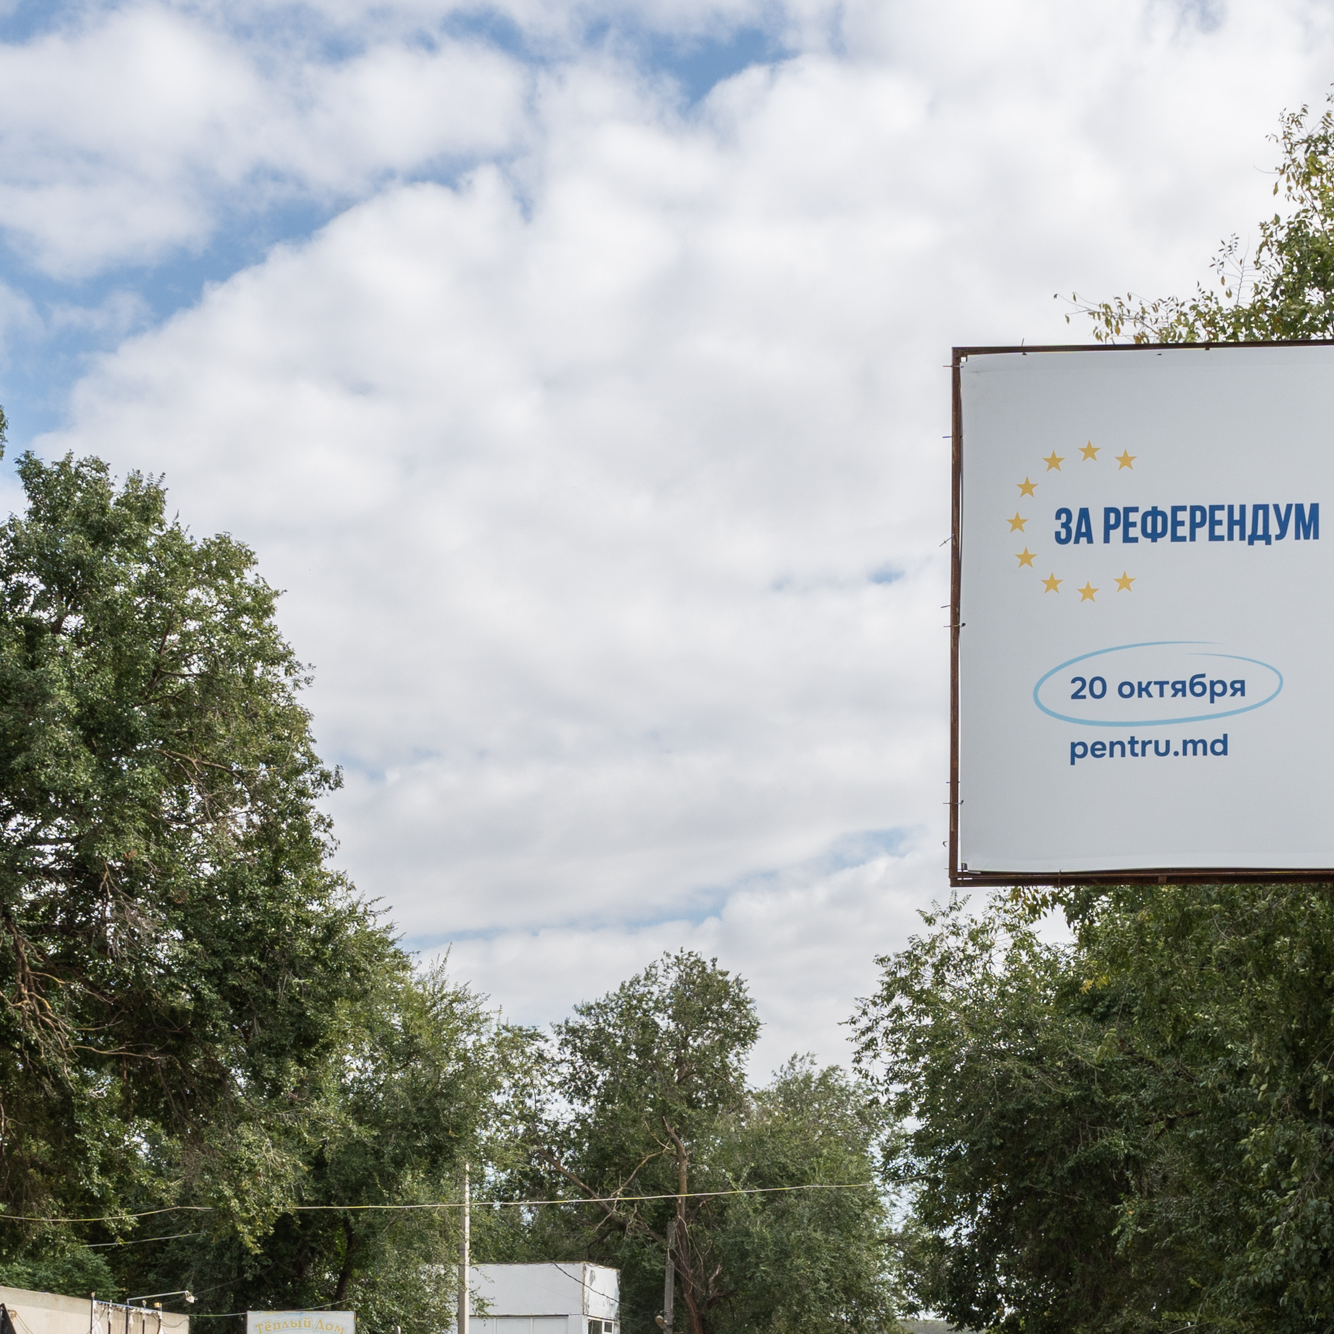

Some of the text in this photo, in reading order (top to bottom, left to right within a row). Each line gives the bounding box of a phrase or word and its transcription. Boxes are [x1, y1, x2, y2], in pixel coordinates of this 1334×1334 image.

[1054, 502, 1320, 546] ЗА РЕФЕРЕНДУМ
[1070, 673, 1246, 703] 20 октября
[1070, 733, 1229, 765] pentru.md
[255, 1316, 345, 1334] Тёплый Дом
